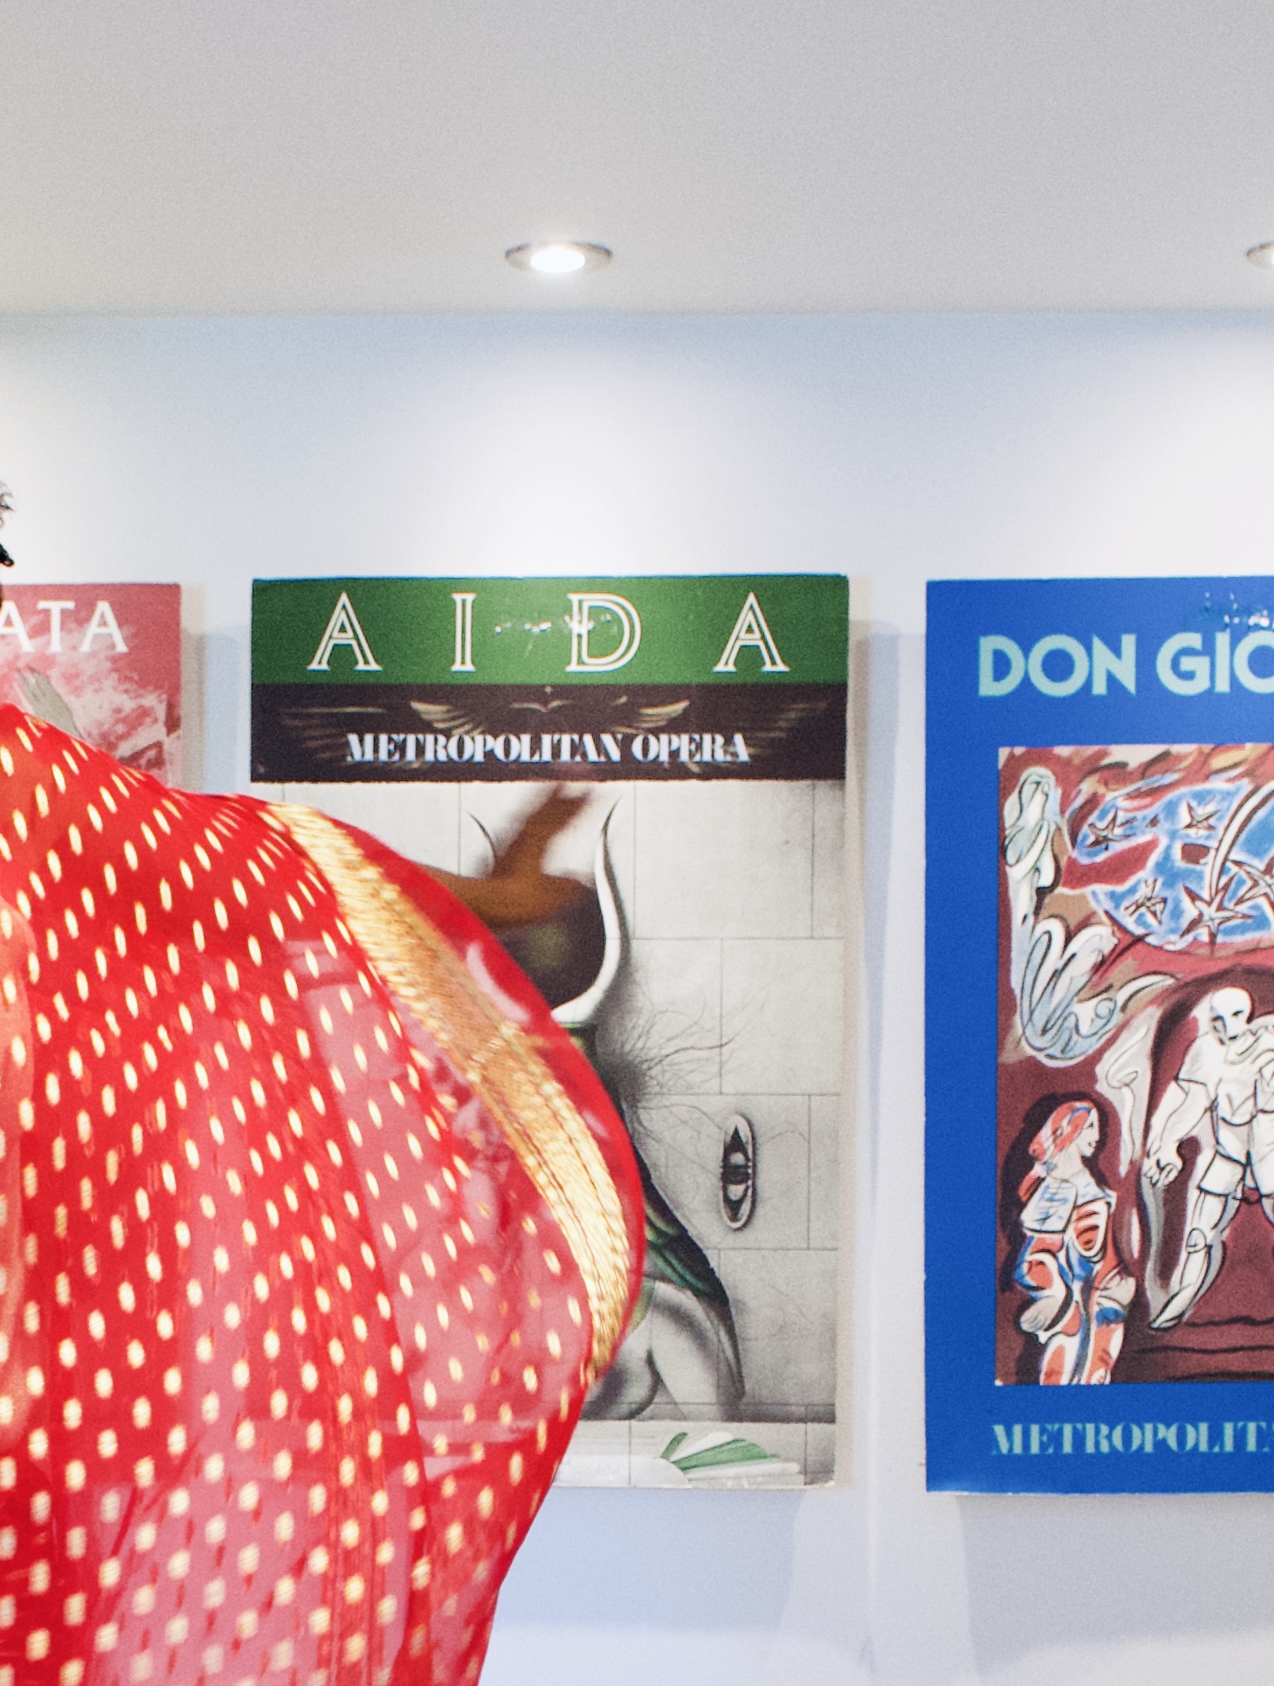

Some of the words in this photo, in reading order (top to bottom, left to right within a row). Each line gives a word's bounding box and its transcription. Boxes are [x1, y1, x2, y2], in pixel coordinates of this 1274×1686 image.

[307, 590, 790, 674] AIDA
[977, 633, 1137, 698] DON
[346, 731, 623, 765] METROPOLITAN
[630, 730, 752, 764] OPERA
